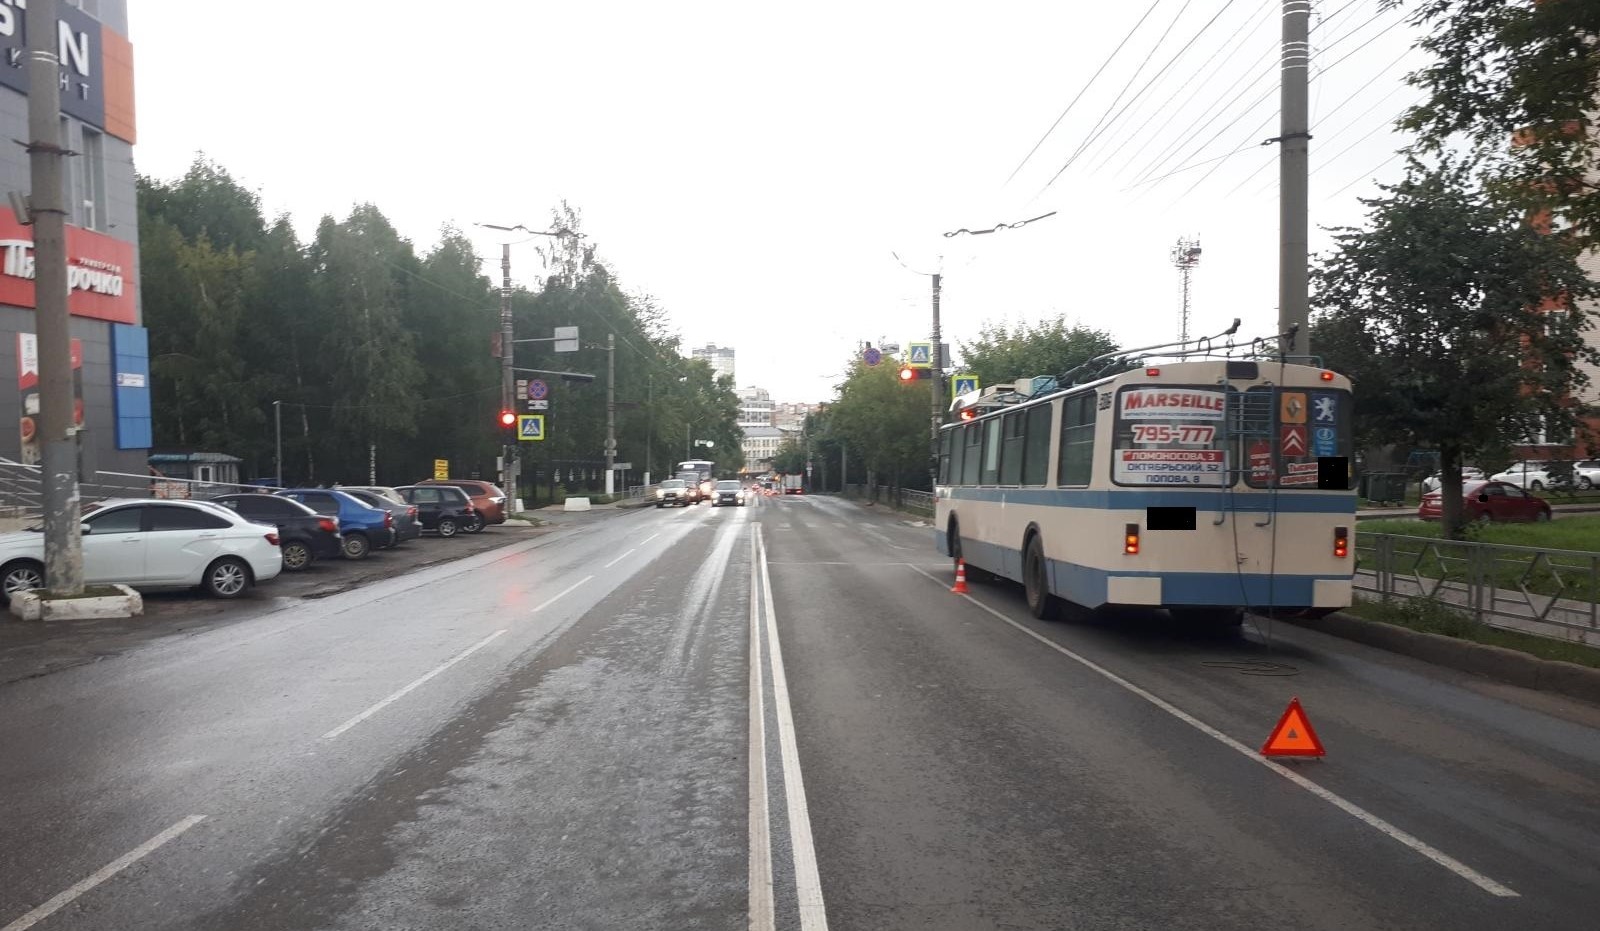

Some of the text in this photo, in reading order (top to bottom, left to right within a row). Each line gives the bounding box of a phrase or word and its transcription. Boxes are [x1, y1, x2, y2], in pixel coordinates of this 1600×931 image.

[1125, 392, 1224, 411] MARSEILLE
[1134, 426, 1214, 442] 795-777
[1208, 452, 1215, 460] 3
[1193, 474, 1200, 483] 8
